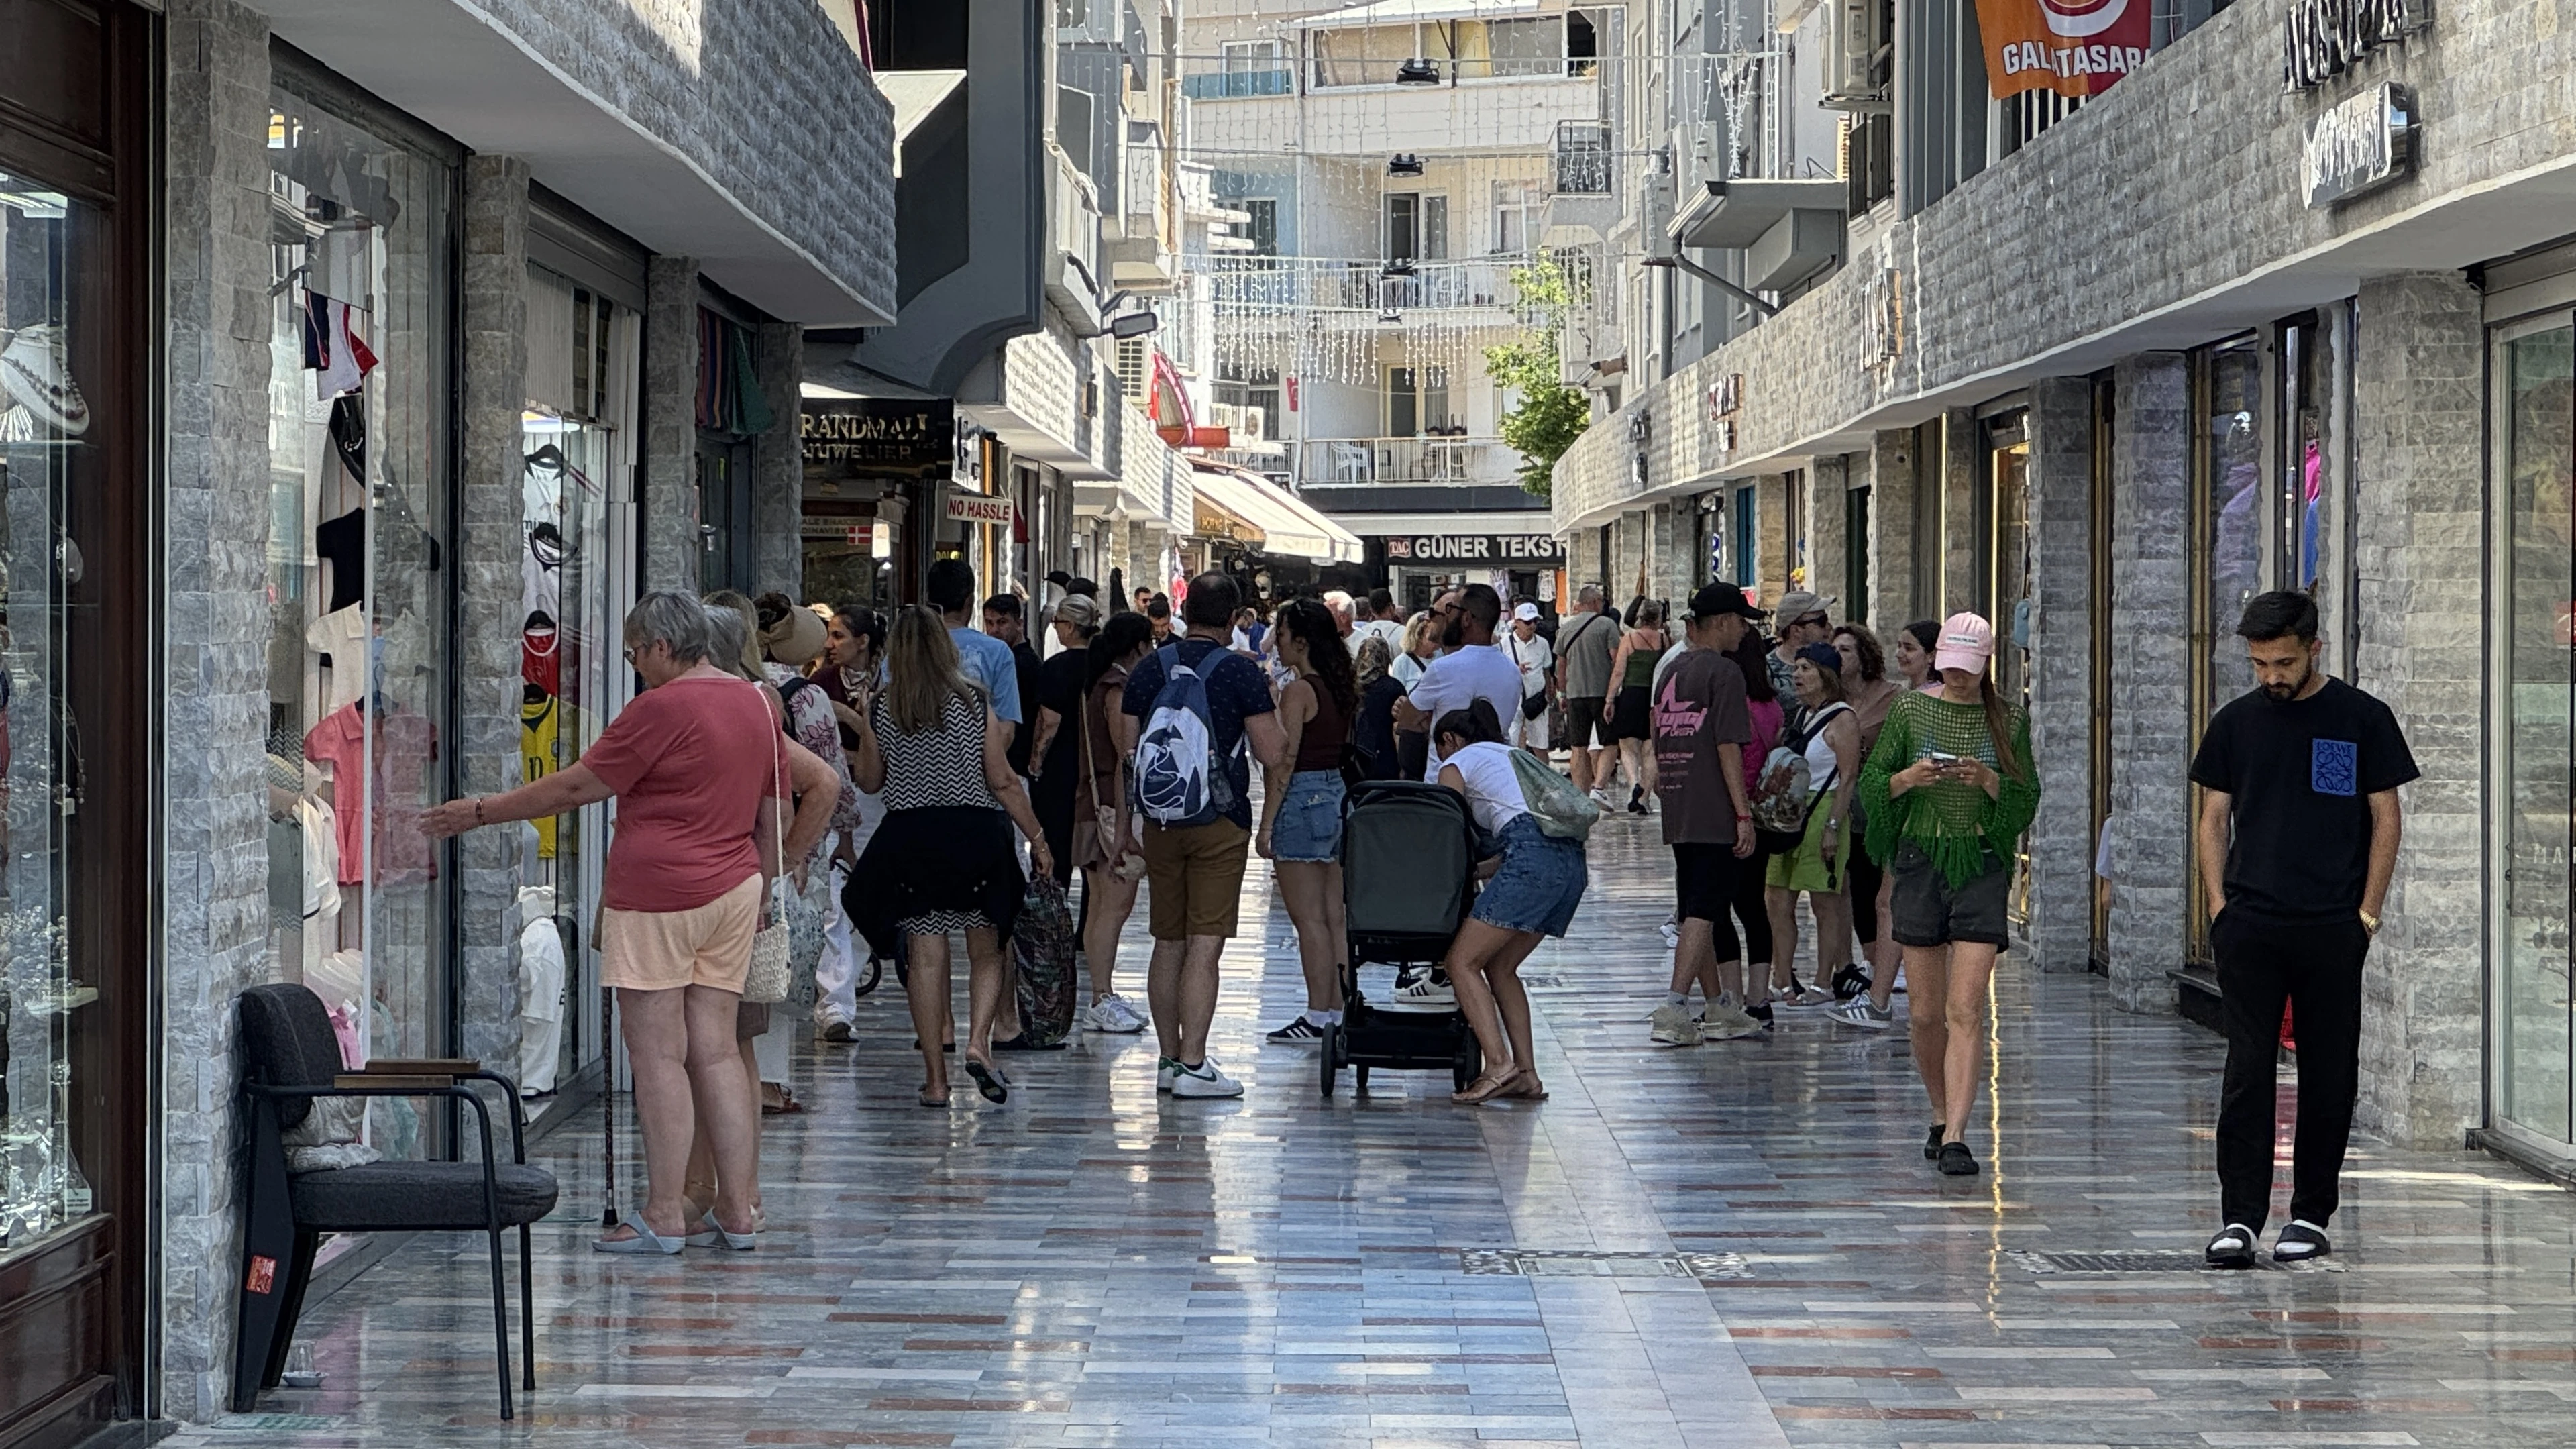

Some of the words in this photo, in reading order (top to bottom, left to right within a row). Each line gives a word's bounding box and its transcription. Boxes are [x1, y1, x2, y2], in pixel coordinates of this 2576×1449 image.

[948, 498, 964, 516] NO
[967, 501, 1010, 521] HASSLE
[1415, 535, 1490, 559] GÜNER
